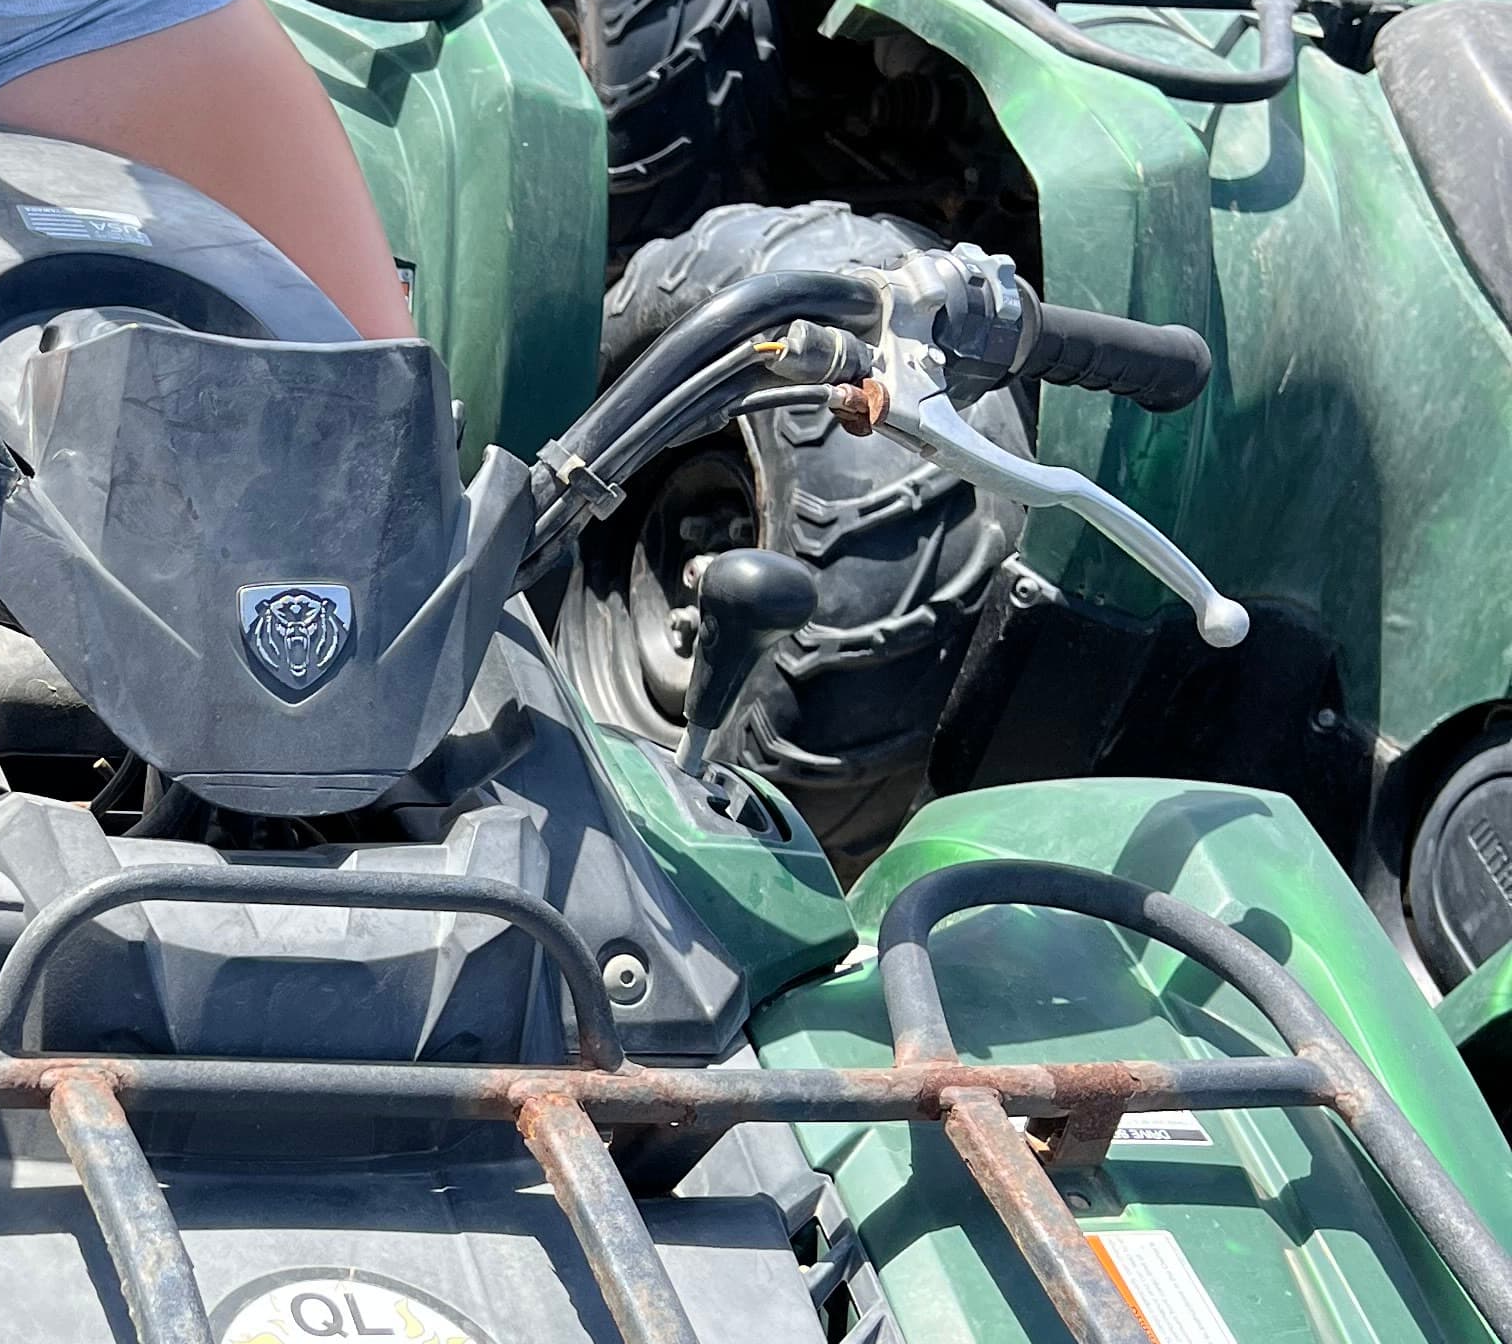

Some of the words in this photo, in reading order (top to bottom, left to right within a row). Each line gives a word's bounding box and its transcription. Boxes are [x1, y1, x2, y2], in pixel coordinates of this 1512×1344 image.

[88, 219, 143, 235] USA
[1129, 1128, 1172, 1140] DRIVE
[289, 1291, 396, 1338] QL
